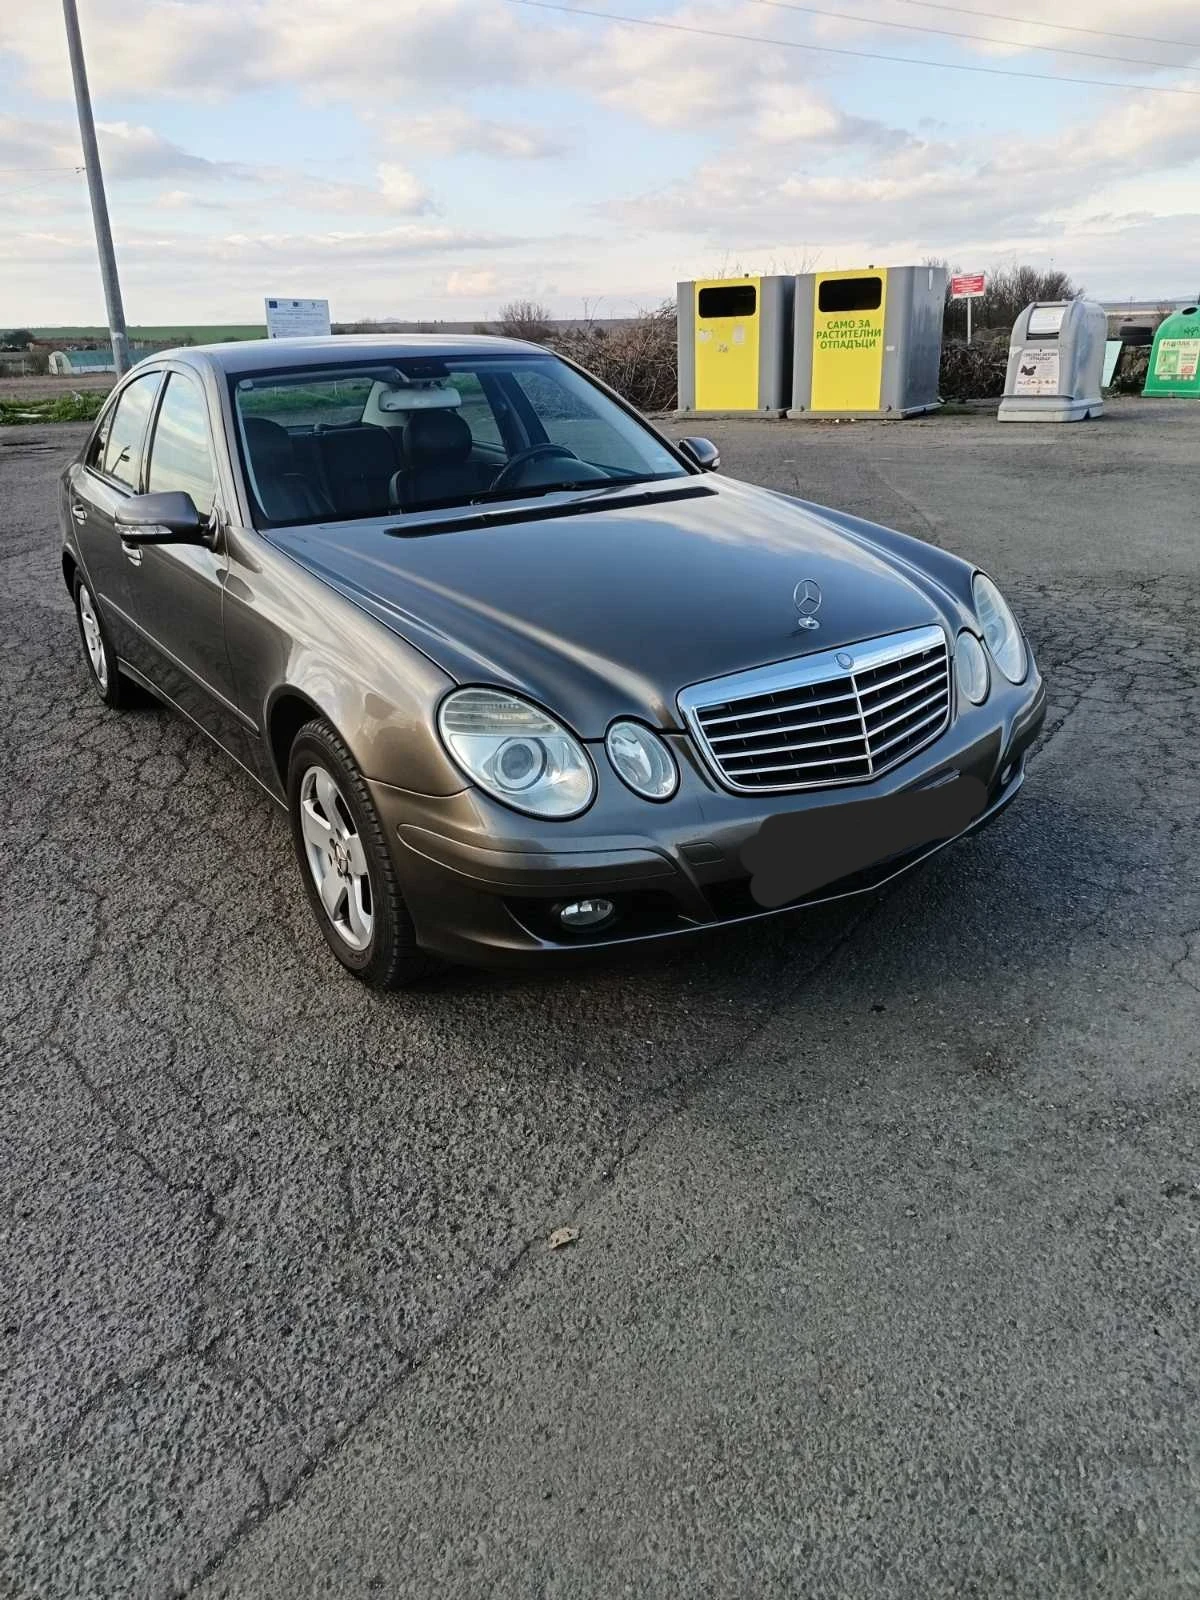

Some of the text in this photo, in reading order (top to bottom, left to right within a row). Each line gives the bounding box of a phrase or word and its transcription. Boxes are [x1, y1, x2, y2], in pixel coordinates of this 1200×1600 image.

[827, 319, 870, 329] САМО ЗА
[816, 329, 881, 339] РАСТИТЕЛНИ
[820, 339, 876, 349] ОТПАДЪЦИ
